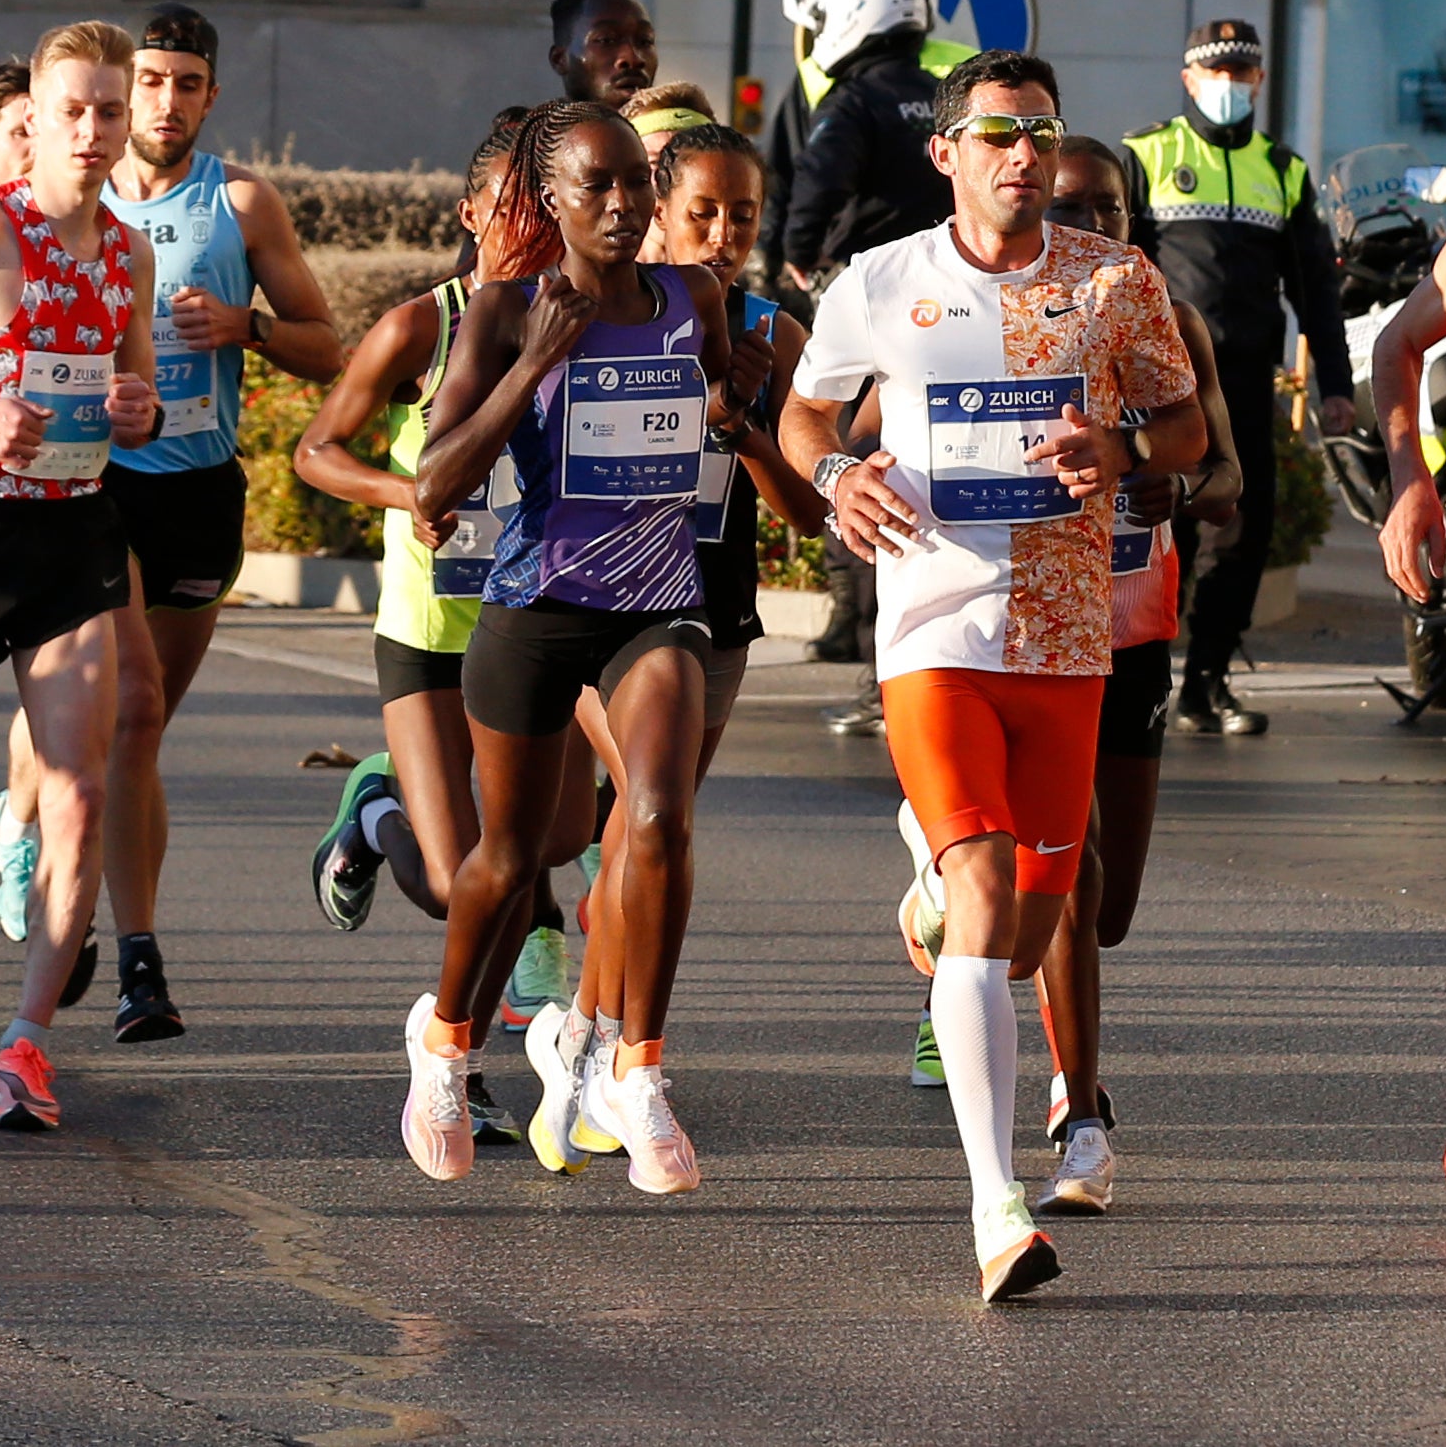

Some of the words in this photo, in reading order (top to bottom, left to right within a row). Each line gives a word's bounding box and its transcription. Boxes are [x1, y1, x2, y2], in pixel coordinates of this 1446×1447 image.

[948, 307, 971, 318] NN
[624, 368, 681, 385] ZURICH
[988, 390, 1055, 406] ZURICH
[642, 412, 680, 432] F20
